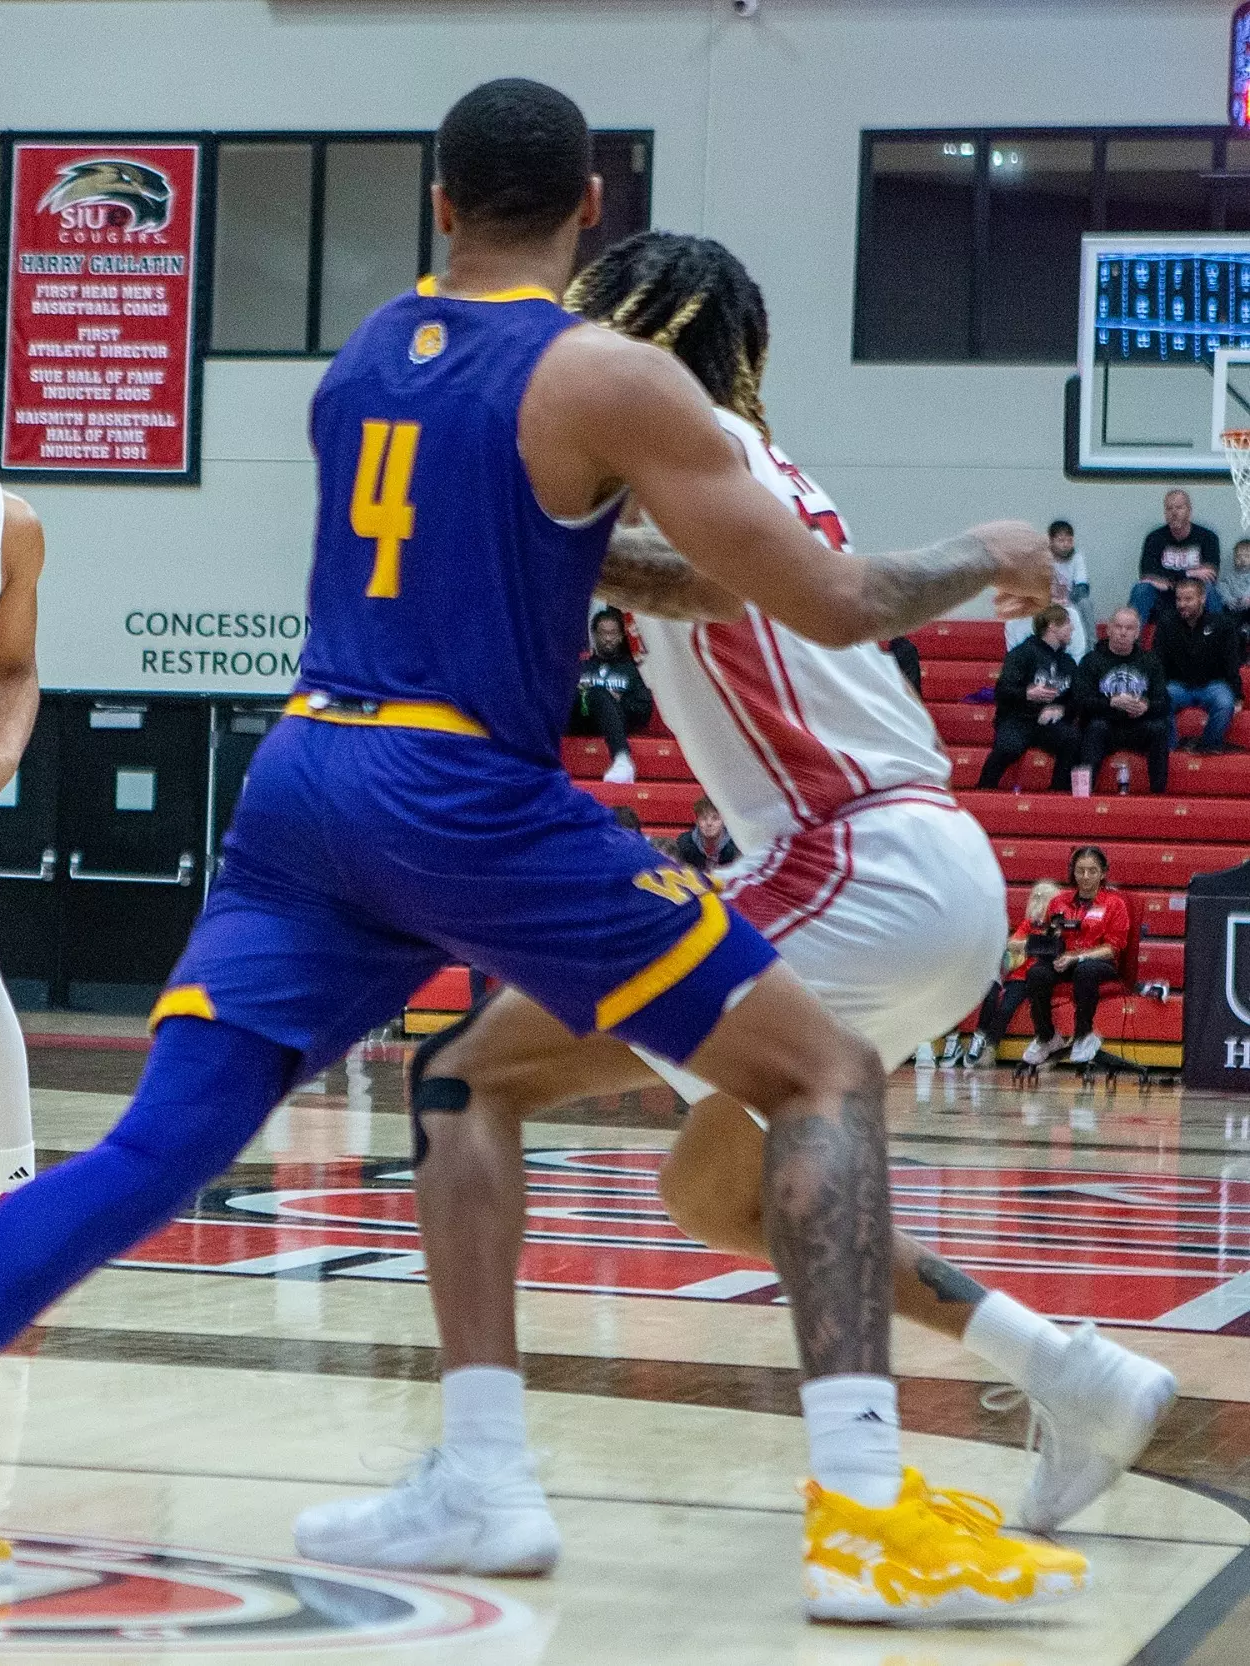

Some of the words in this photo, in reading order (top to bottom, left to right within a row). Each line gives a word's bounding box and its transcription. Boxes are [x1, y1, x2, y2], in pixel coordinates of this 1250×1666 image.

[19, 255, 85, 274] HARRY
[89, 255, 185, 275] GALLATIN
[36, 285, 78, 299] FIRST
[81, 285, 118, 299] HEAD
[122, 286, 165, 300] MEN'S
[31, 301, 120, 315] BASKETBALL
[122, 302, 168, 316] COACH
[78, 328, 120, 342] FIRST
[28, 344, 96, 357] ATHLETIC
[100, 345, 168, 359] DIRECTOR
[30, 370, 63, 383] SIUE
[67, 370, 101, 384] HALL
[104, 371, 123, 384] OF
[127, 371, 164, 385] FAME
[42, 386, 111, 400] INDUCTEE
[15, 411, 83, 425] NAISMITH
[87, 412, 176, 427] BASKETBALL
[46, 428, 81, 442] HALL
[85, 429, 103, 442] OF
[106, 429, 145, 443] FAME
[40, 445, 110, 459] INDUCTEE
[115, 446, 147, 460] 1991
[350, 420, 421, 598] 4
